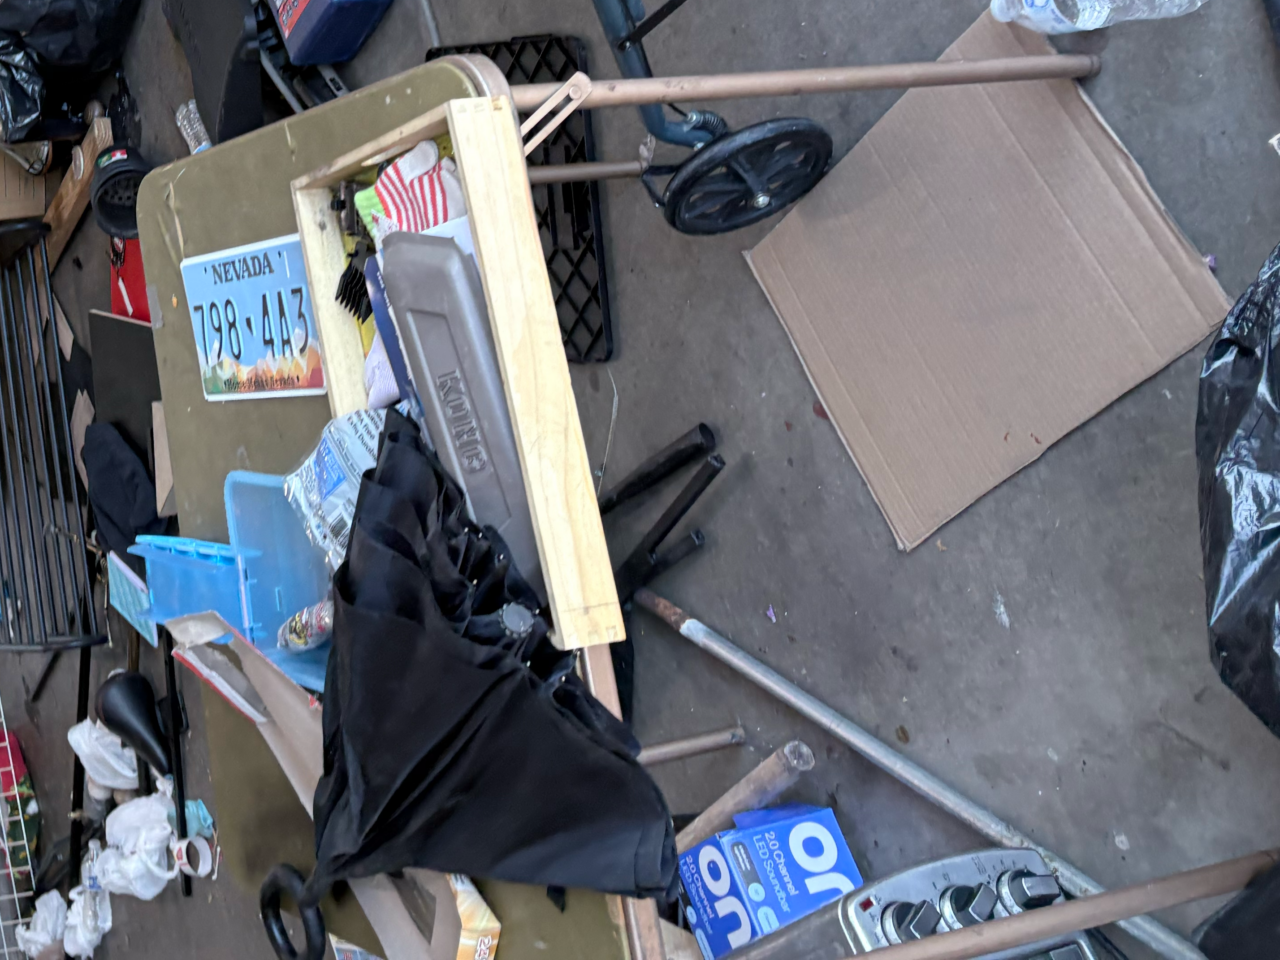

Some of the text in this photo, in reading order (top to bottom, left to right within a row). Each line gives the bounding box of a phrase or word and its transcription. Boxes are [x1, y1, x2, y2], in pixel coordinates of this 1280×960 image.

[211, 250, 275, 286] NEVADA
[680, 859, 693, 883] LED
[753, 835, 792, 914] LED Soundbar
[773, 850, 799, 897] Channel
[694, 874, 715, 919] Channel
